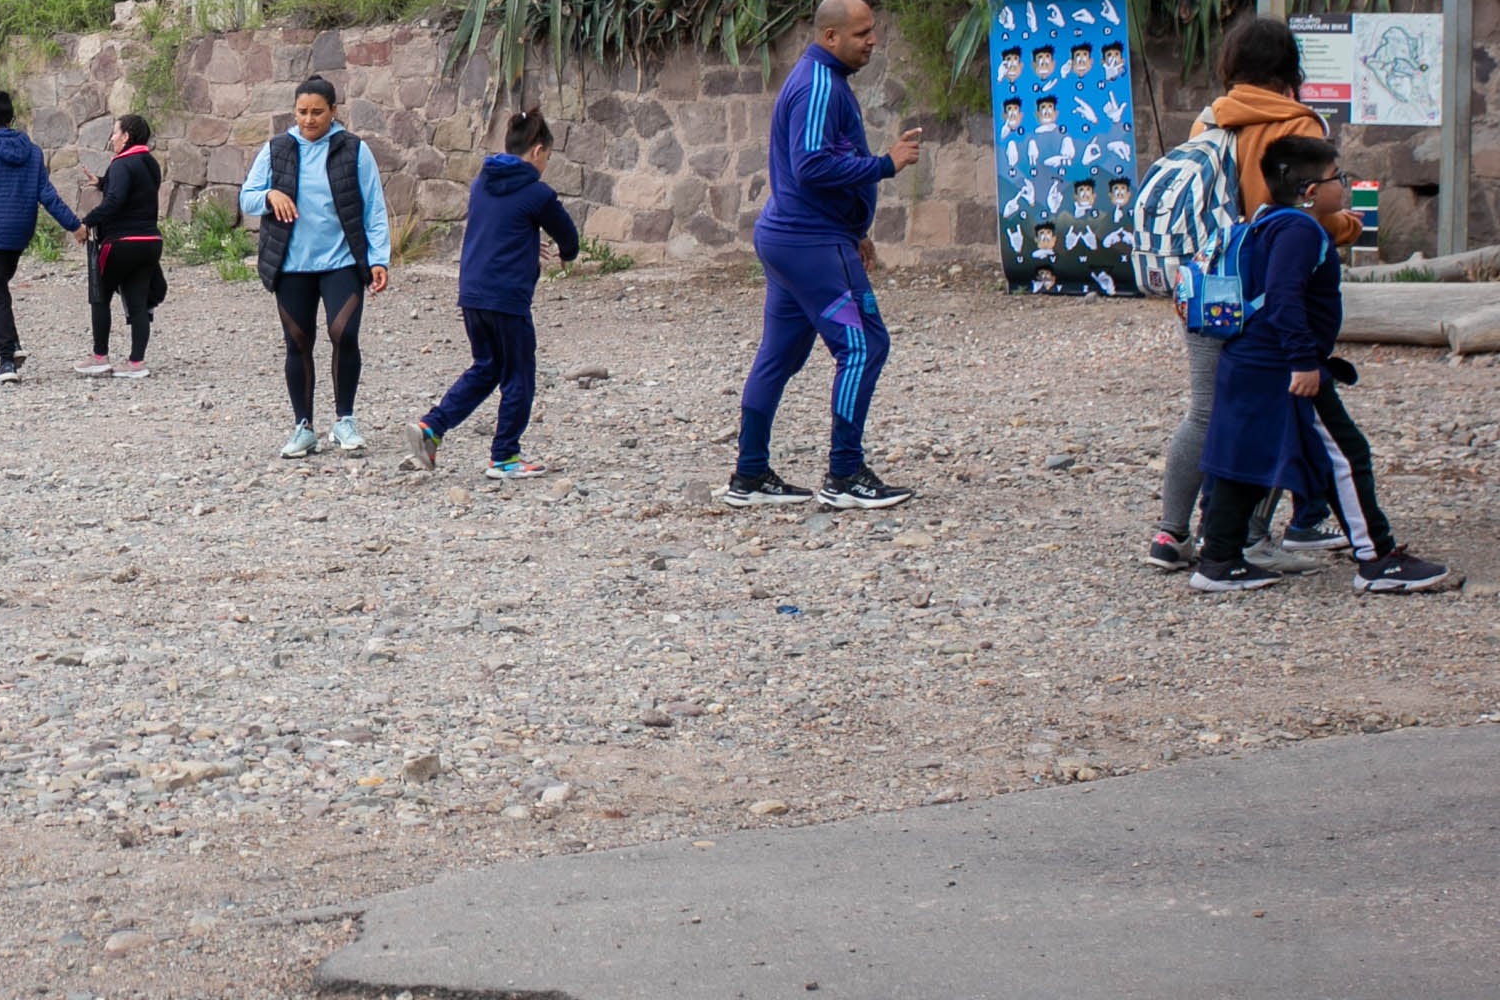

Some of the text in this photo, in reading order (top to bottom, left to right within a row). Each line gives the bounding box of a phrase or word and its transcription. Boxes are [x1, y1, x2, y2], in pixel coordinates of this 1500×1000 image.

[1289, 23, 1348, 31] MOUNTAIN BIKE
[851, 484, 877, 497] FILA
